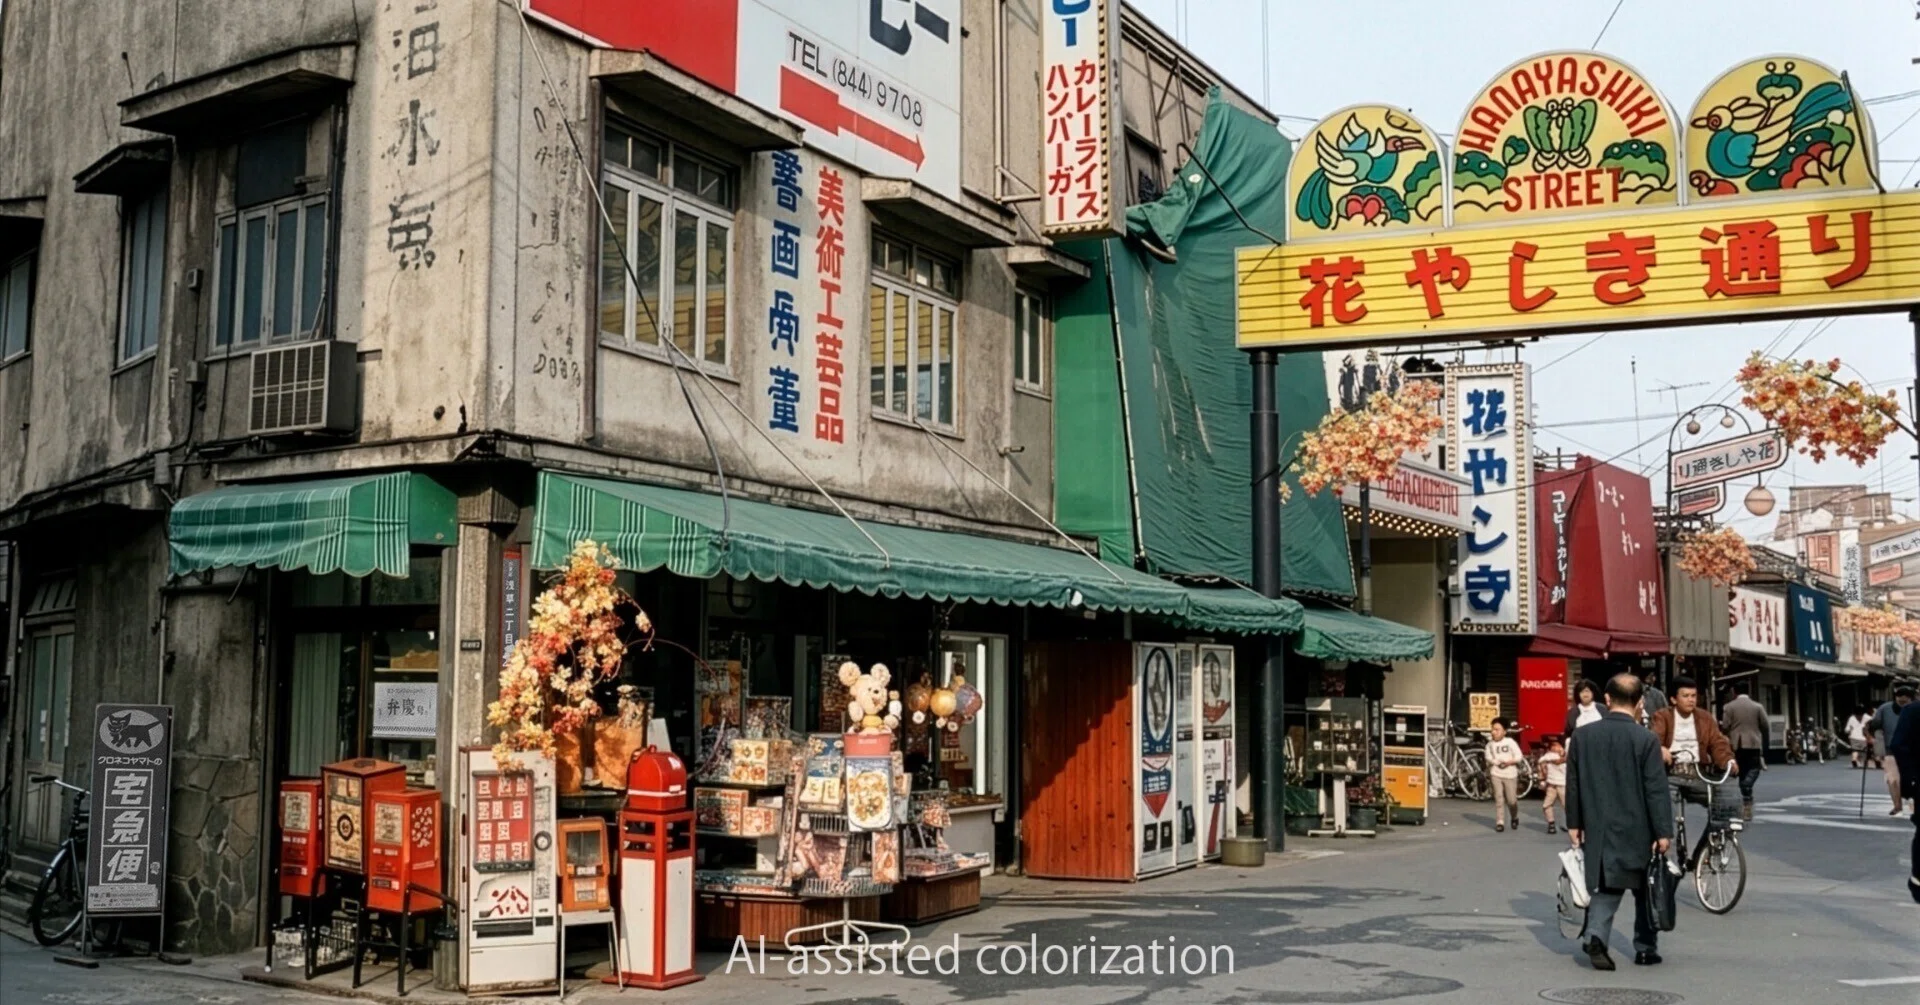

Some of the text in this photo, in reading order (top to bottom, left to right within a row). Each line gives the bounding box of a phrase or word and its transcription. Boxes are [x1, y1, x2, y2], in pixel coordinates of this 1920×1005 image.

[788, 31, 923, 127] TEL (844) 9708
[1460, 55, 1668, 153] HANAYASHIKI
[1073, 59, 1100, 219] カレーライス
[1503, 166, 1623, 212] STREET
[815, 165, 846, 445] 美術工芸品
[1300, 209, 1873, 327] 花やしき通り
[97, 756, 163, 766] クロネコヤマトの
[107, 773, 149, 882] 宅急便
